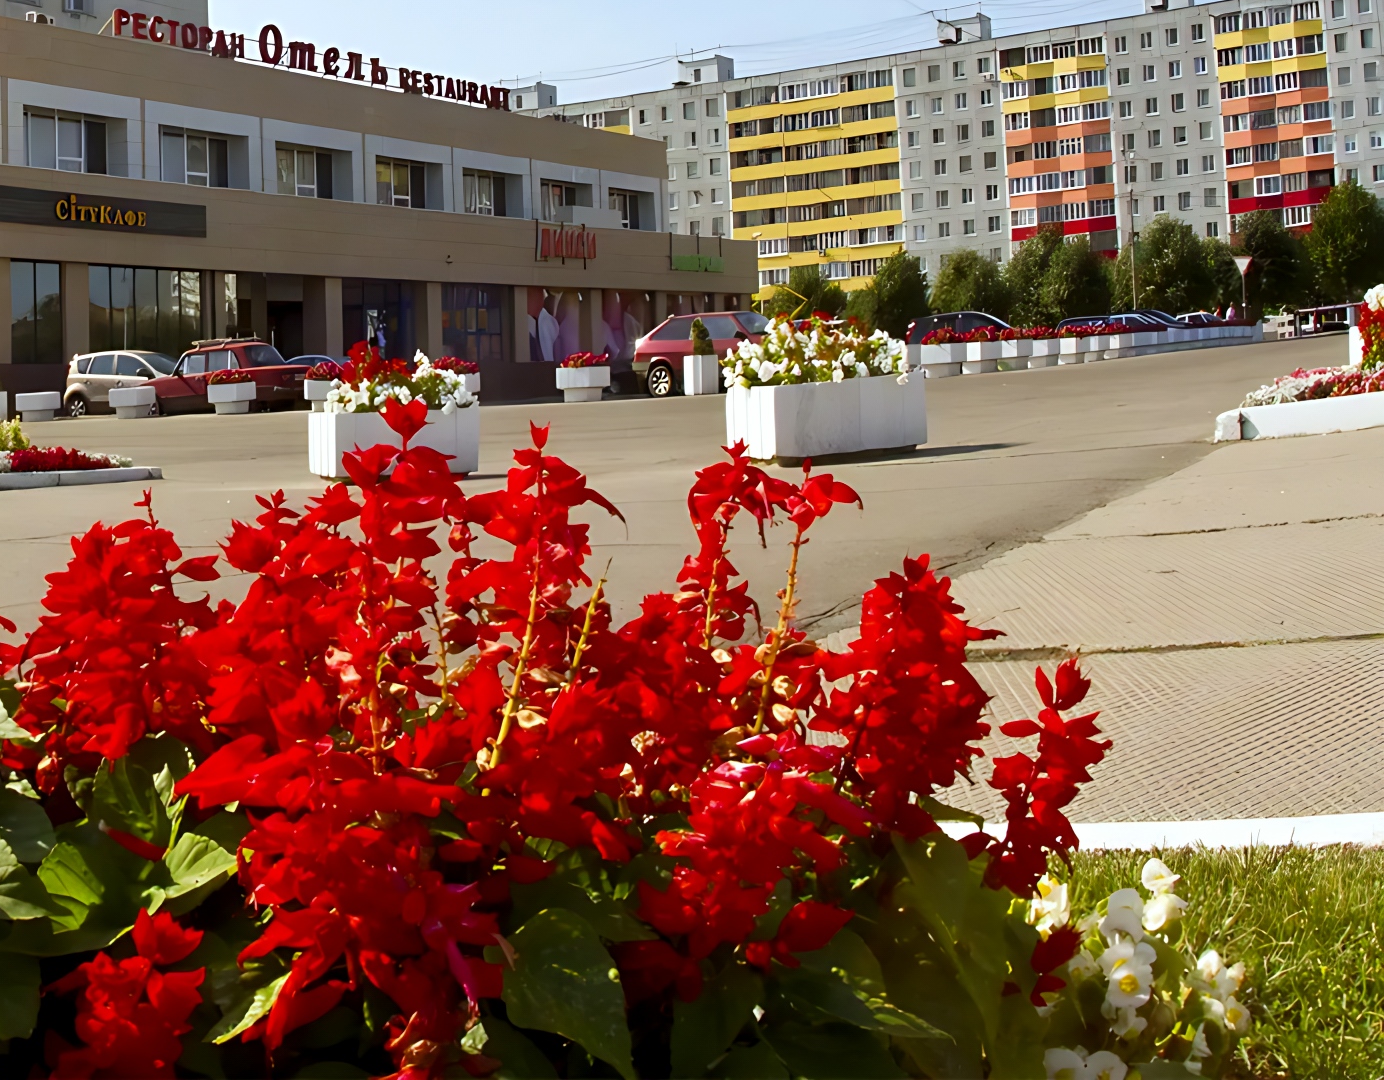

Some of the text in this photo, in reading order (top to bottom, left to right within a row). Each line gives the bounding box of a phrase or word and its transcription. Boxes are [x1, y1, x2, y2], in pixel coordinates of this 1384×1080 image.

[113, 8, 511, 112] РЕСТОРАН Отель RESTAURANT
